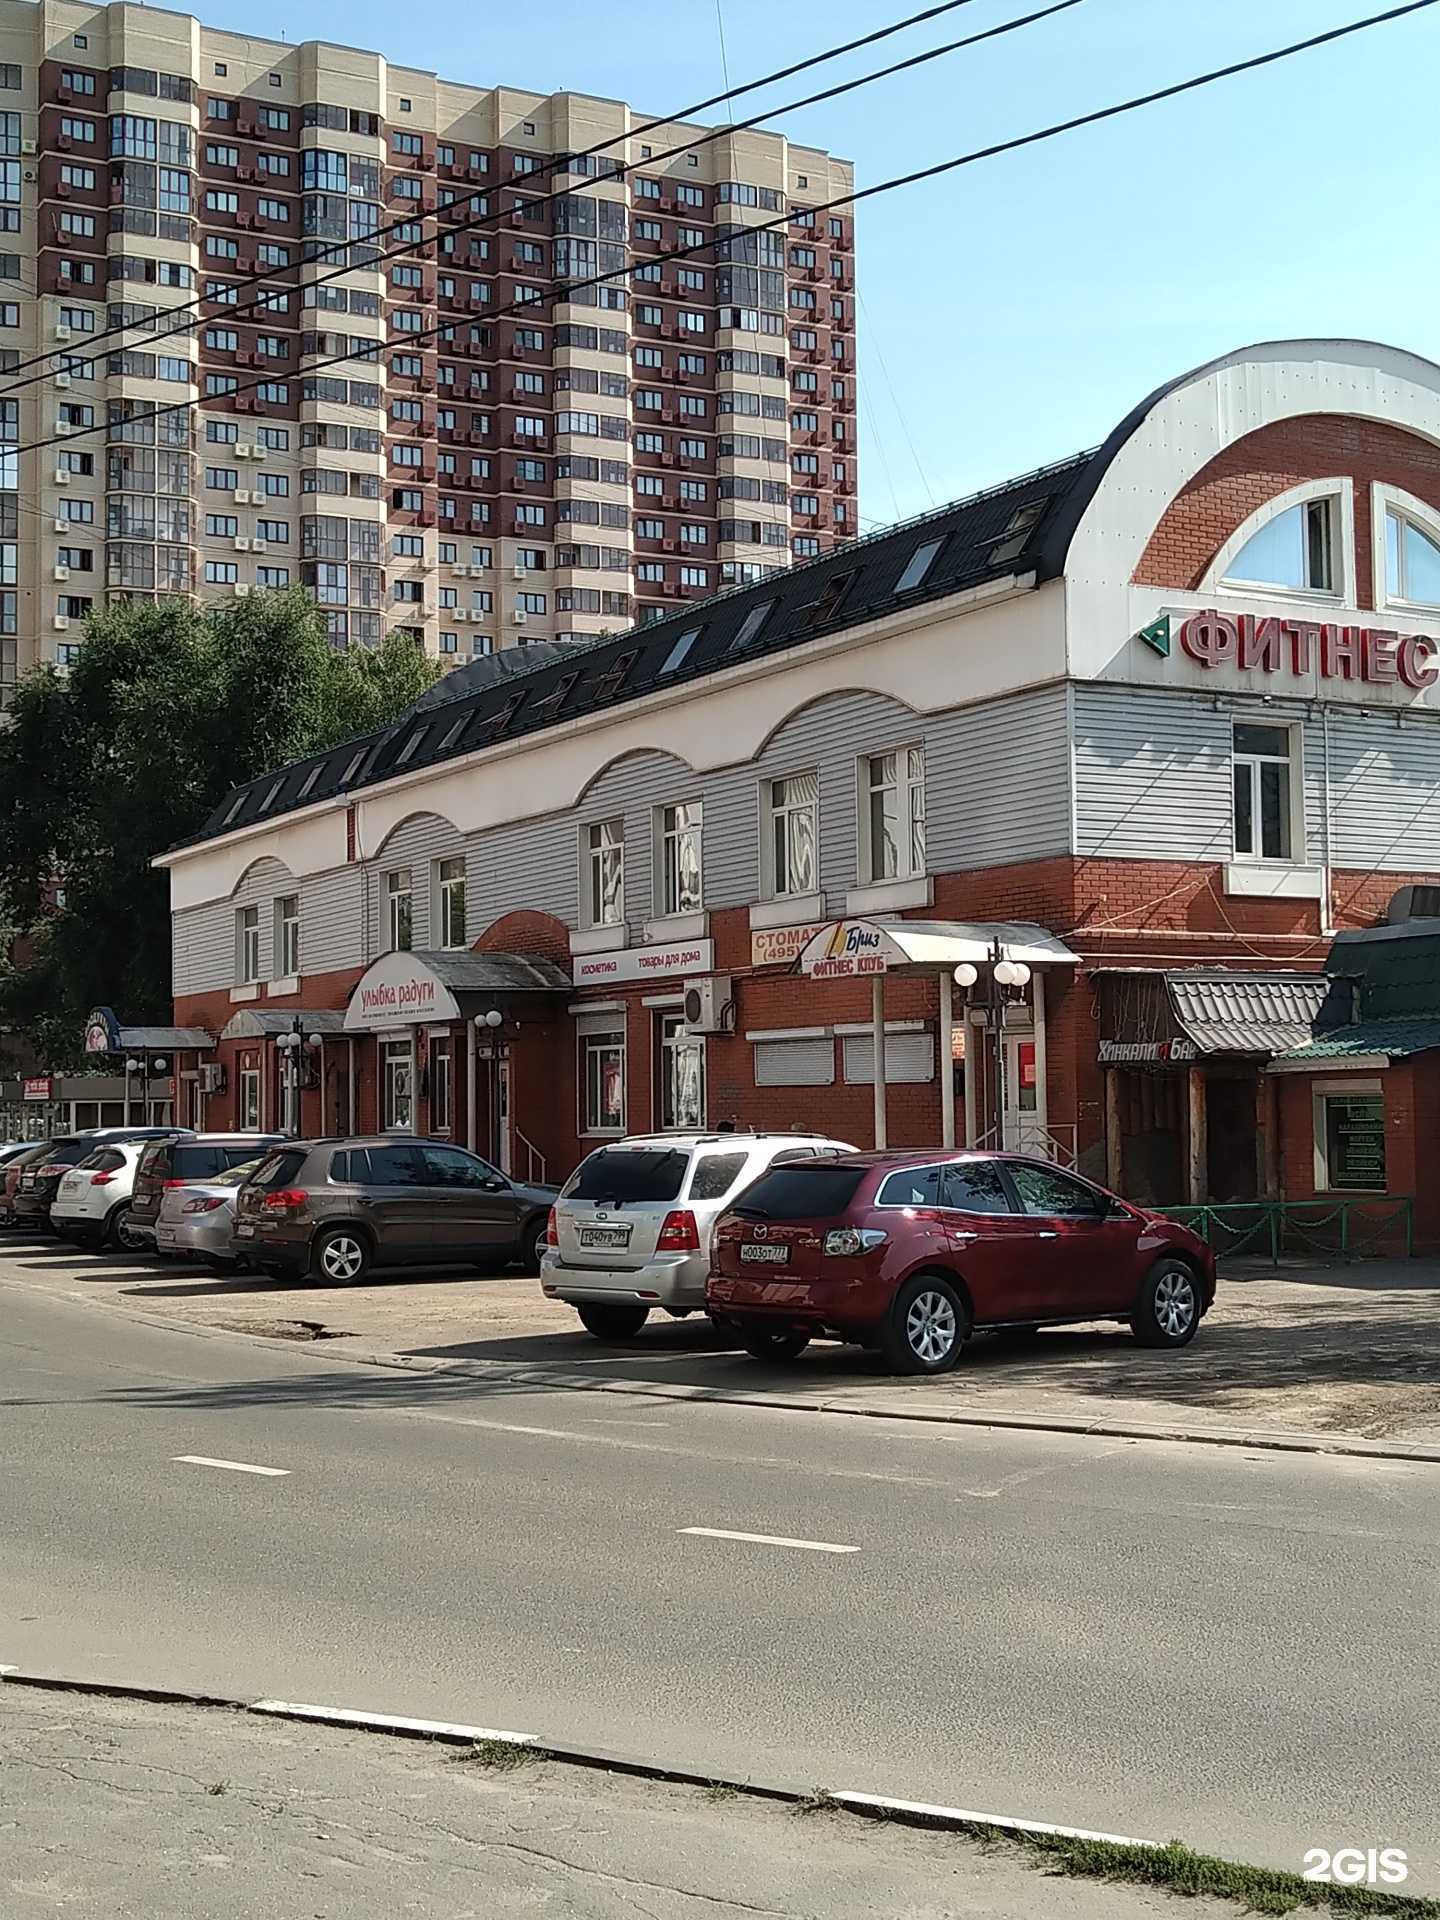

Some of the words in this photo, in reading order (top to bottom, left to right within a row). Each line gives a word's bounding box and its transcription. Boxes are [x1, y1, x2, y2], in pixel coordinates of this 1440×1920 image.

[1180, 609, 1439, 688] ФИТНЕС
[756, 927, 822, 948] СТОМА
[846, 926, 880, 953] Бриз
[638, 954, 664, 969] товары
[665, 953, 680, 968] для
[680, 950, 701, 966] дома
[813, 958, 854, 977] ФИТНЕС
[857, 955, 884, 973] КЛУБ
[361, 983, 396, 1012] улыбка
[399, 978, 435, 1009] радуги
